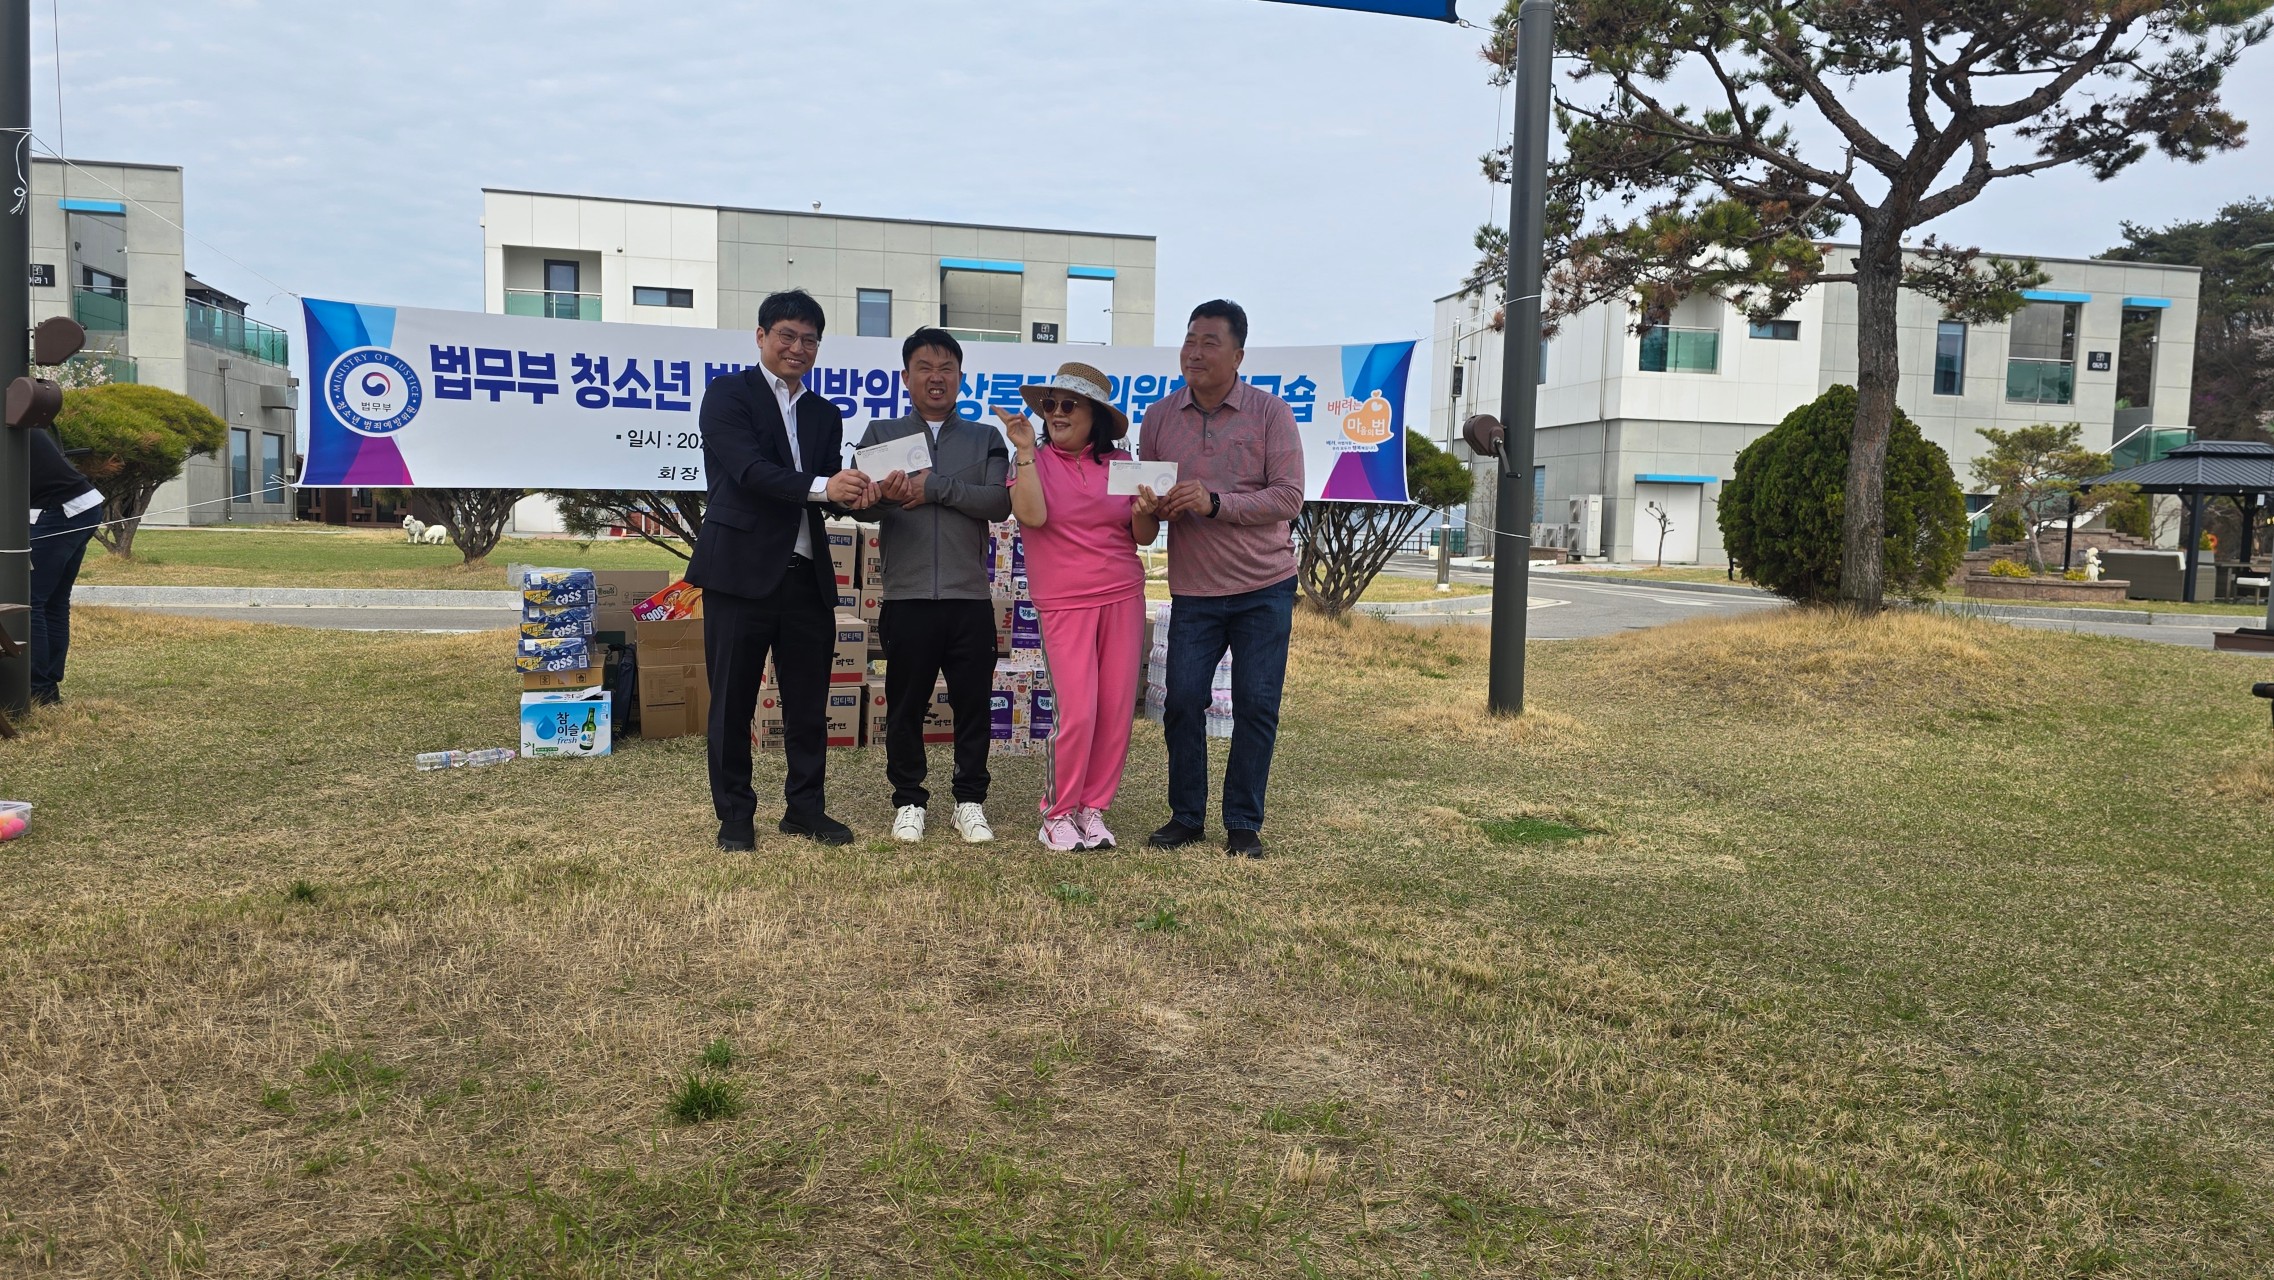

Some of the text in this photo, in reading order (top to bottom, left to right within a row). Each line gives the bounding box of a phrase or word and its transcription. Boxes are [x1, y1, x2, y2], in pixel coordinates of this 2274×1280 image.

[333, 353, 419, 398] MINISTRY OF JUSTICE
[429, 344, 559, 405] 법무부
[571, 352, 692, 412] 청소년
[336, 400, 418, 430] 청소년 범죄예방위원
[361, 401, 392, 412] 법무부
[1327, 398, 1363, 416] 배려는
[627, 429, 661, 449] 일시
[556, 711, 570, 725] 참
[557, 723, 580, 737] 이슬
[556, 736, 578, 745] fresh
